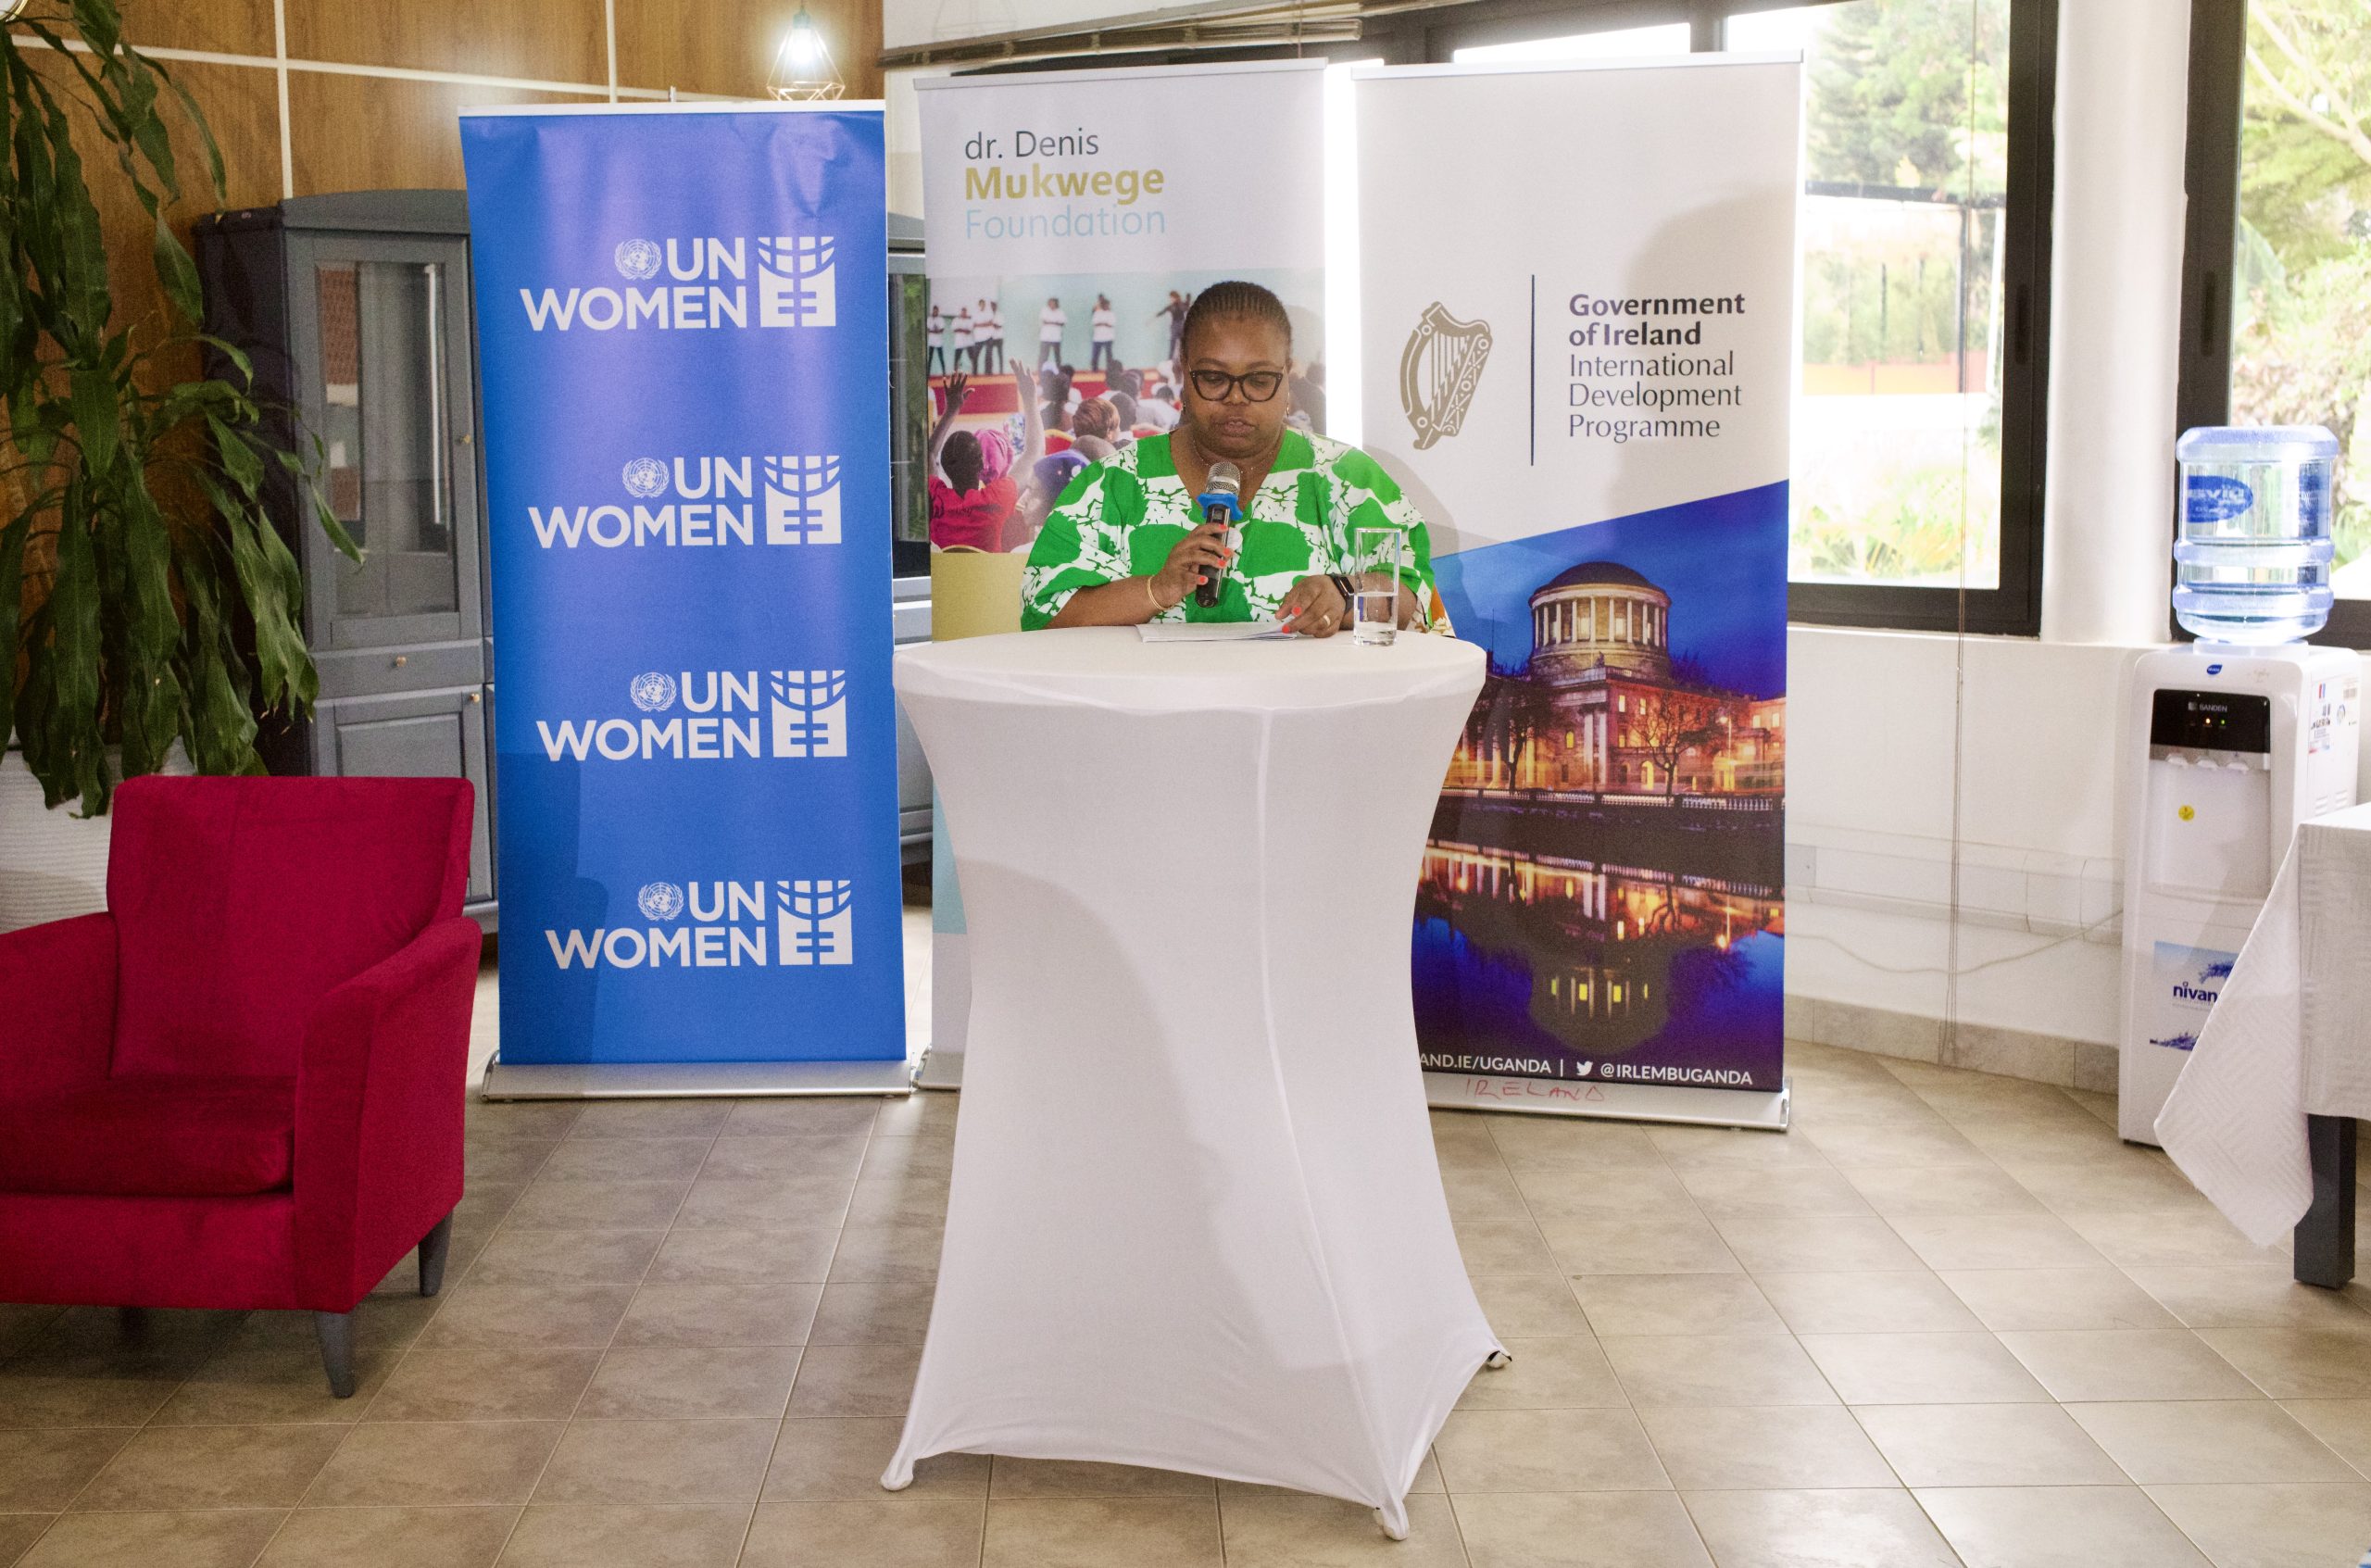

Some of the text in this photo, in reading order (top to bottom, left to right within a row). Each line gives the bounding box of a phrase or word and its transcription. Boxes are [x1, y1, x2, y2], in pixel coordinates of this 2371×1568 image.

[964, 127, 1100, 160] dr. Denis
[965, 163, 1165, 205] Mukwege
[966, 204, 1166, 239] Foundation
[667, 237, 746, 281] UN
[520, 285, 747, 332] WOMEN
[1569, 293, 1746, 317] Government
[1569, 320, 1701, 346] of Ireland
[1570, 350, 1734, 377] International
[1570, 381, 1742, 413] Development
[1570, 413, 1721, 444] Programme
[674, 456, 753, 499] UN
[528, 504, 754, 549] WOMEN
[682, 671, 759, 712] UN
[536, 718, 760, 761] WOMEN
[689, 881, 766, 922] UN
[545, 927, 767, 970] WOMEN
[2173, 981, 2219, 1003] nivan
[1465, 1077, 1607, 1102] IRELAND
[1600, 1063, 1753, 1085] @IRLEMBUGANDA
